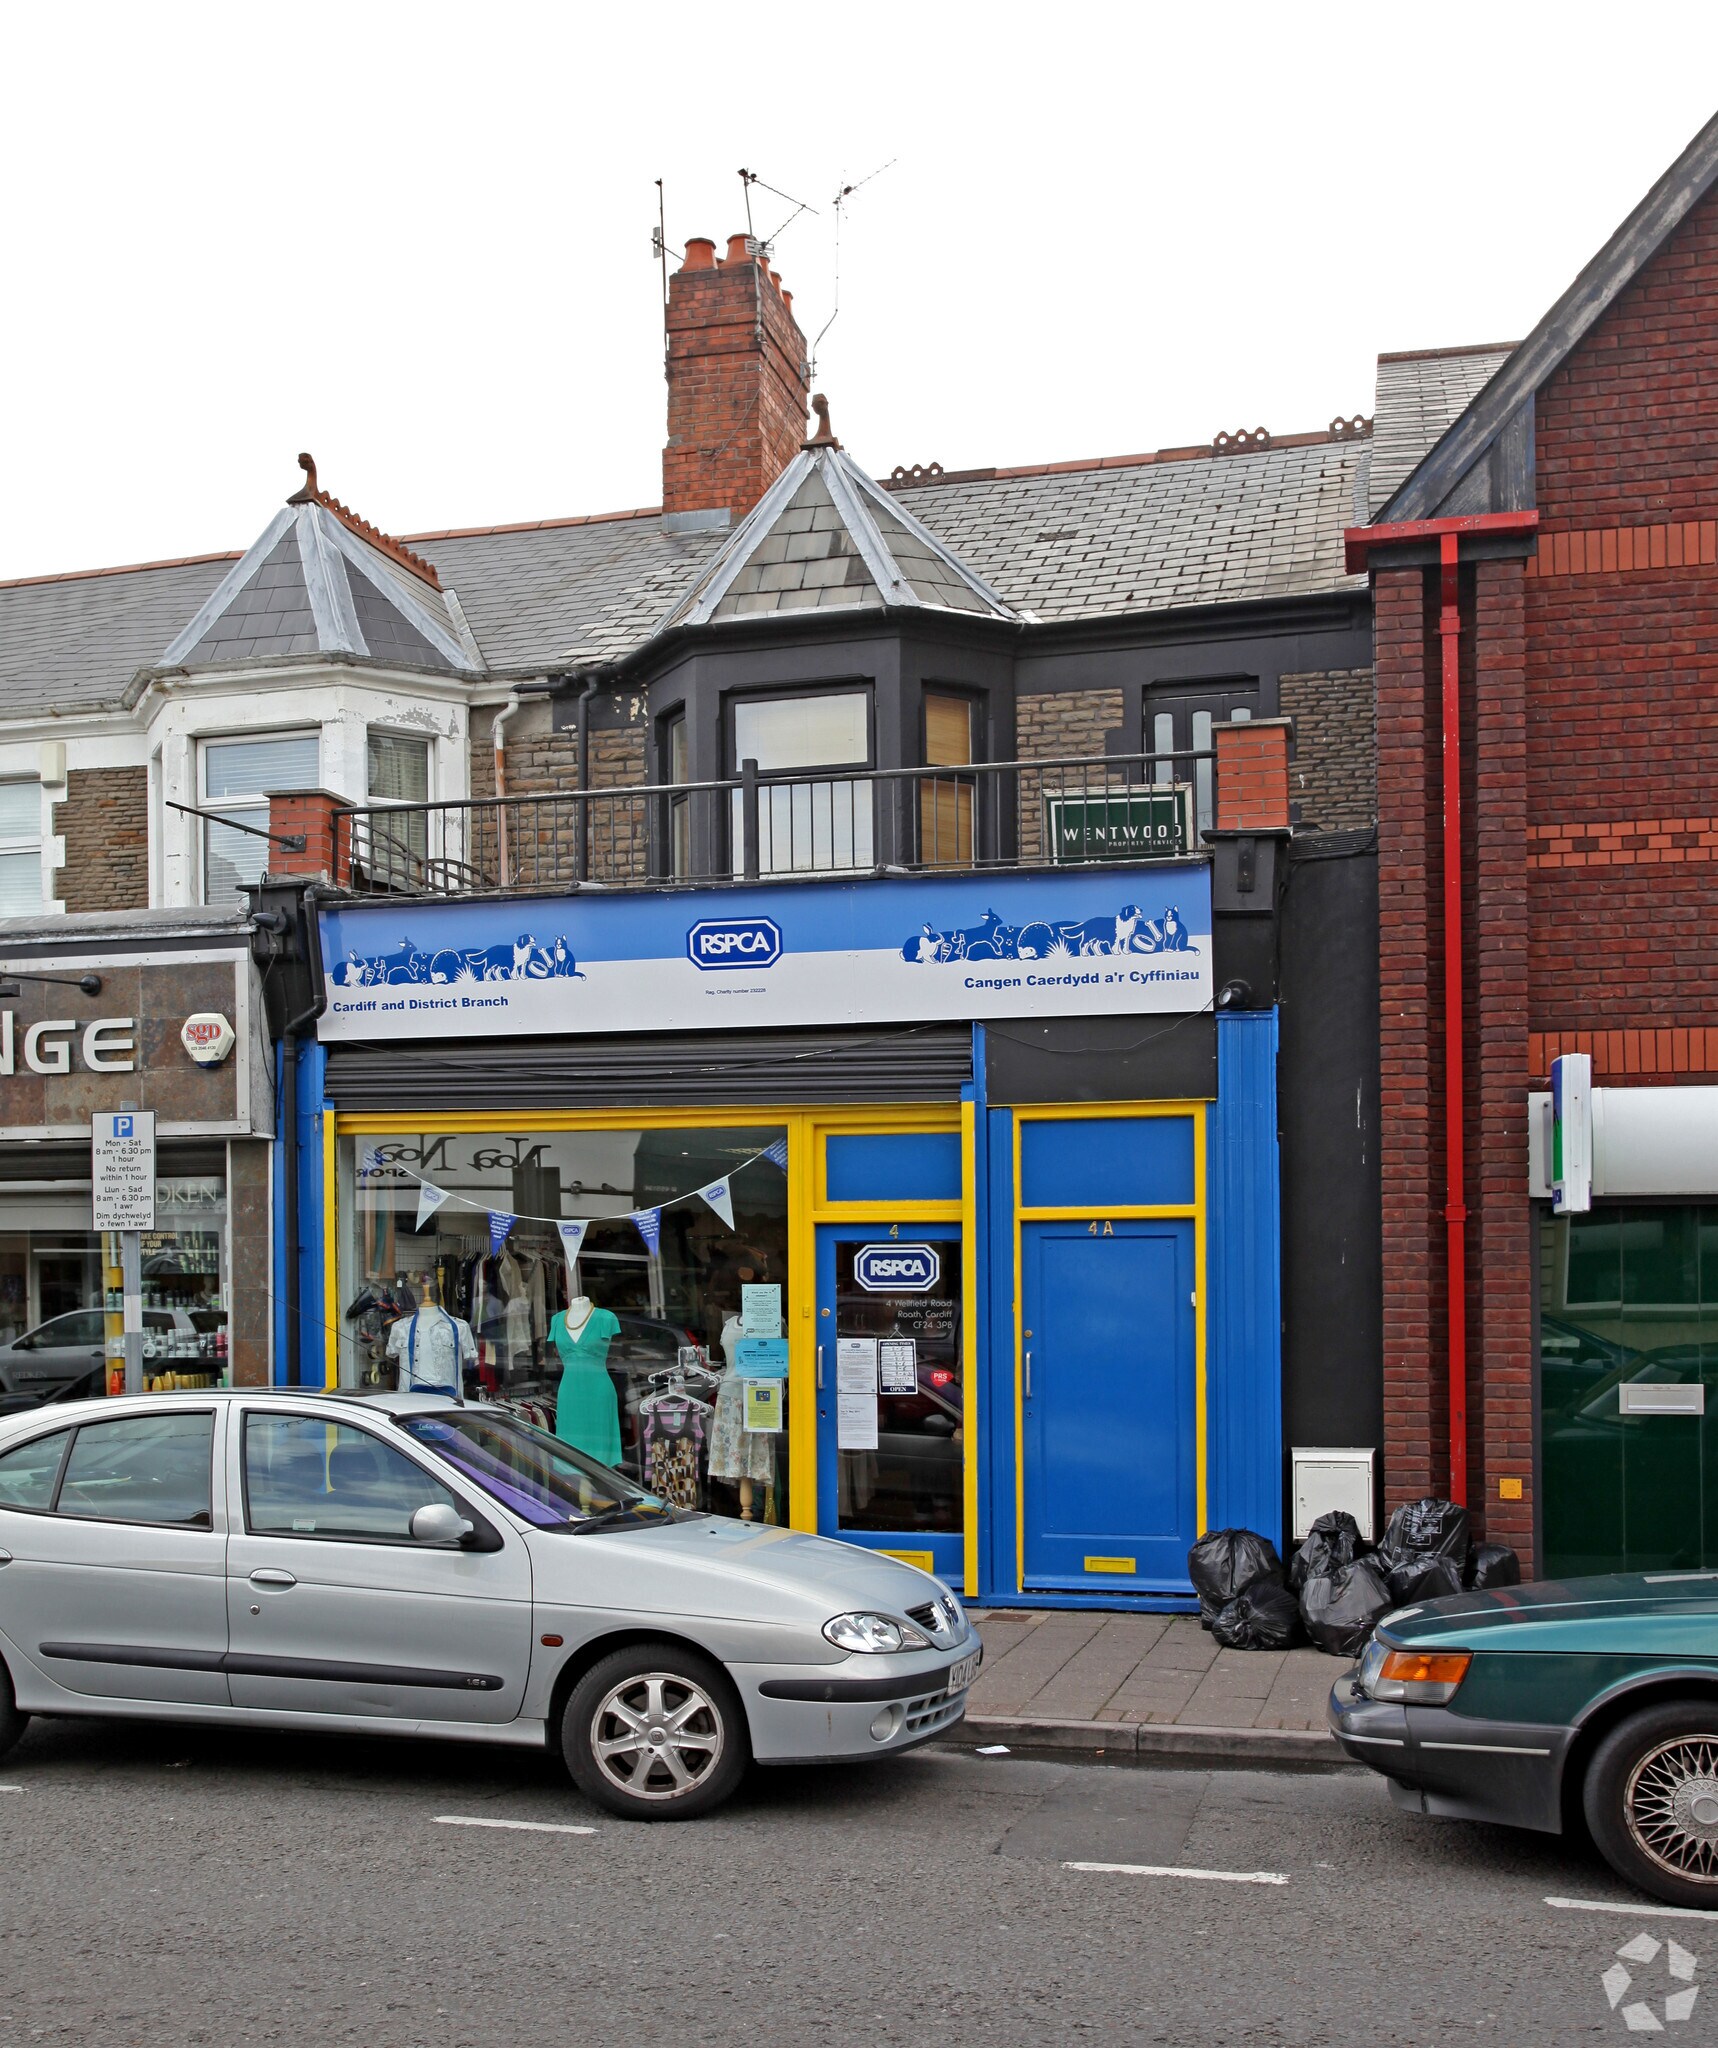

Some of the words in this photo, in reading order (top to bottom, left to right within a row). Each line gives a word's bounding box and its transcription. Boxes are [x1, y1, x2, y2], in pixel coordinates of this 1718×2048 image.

[700, 931, 771, 954] RSPCA
[964, 976, 1021, 990] Cangen
[1026, 973, 1100, 987] Caerdydd
[1105, 972, 1125, 983] a'r
[1129, 970, 1200, 984] Cyffiniau
[333, 1001, 377, 1012] Cardiff
[381, 1000, 405, 1011] and
[409, 998, 457, 1010] District
[461, 996, 509, 1008] Branch
[118, 1118, 130, 1136] P
[112, 1212, 151, 1220] dychwelyd
[889, 1224, 899, 1240] 4
[870, 1259, 926, 1276] RSPCA
[894, 1299, 927, 1307] Wellfield
[930, 1299, 952, 1307] Road
[897, 1310, 923, 1319] Roath,
[925, 1310, 952, 1318] Cardiff
[912, 1321, 933, 1329] CF24
[933, 1372, 948, 1380] PRS
